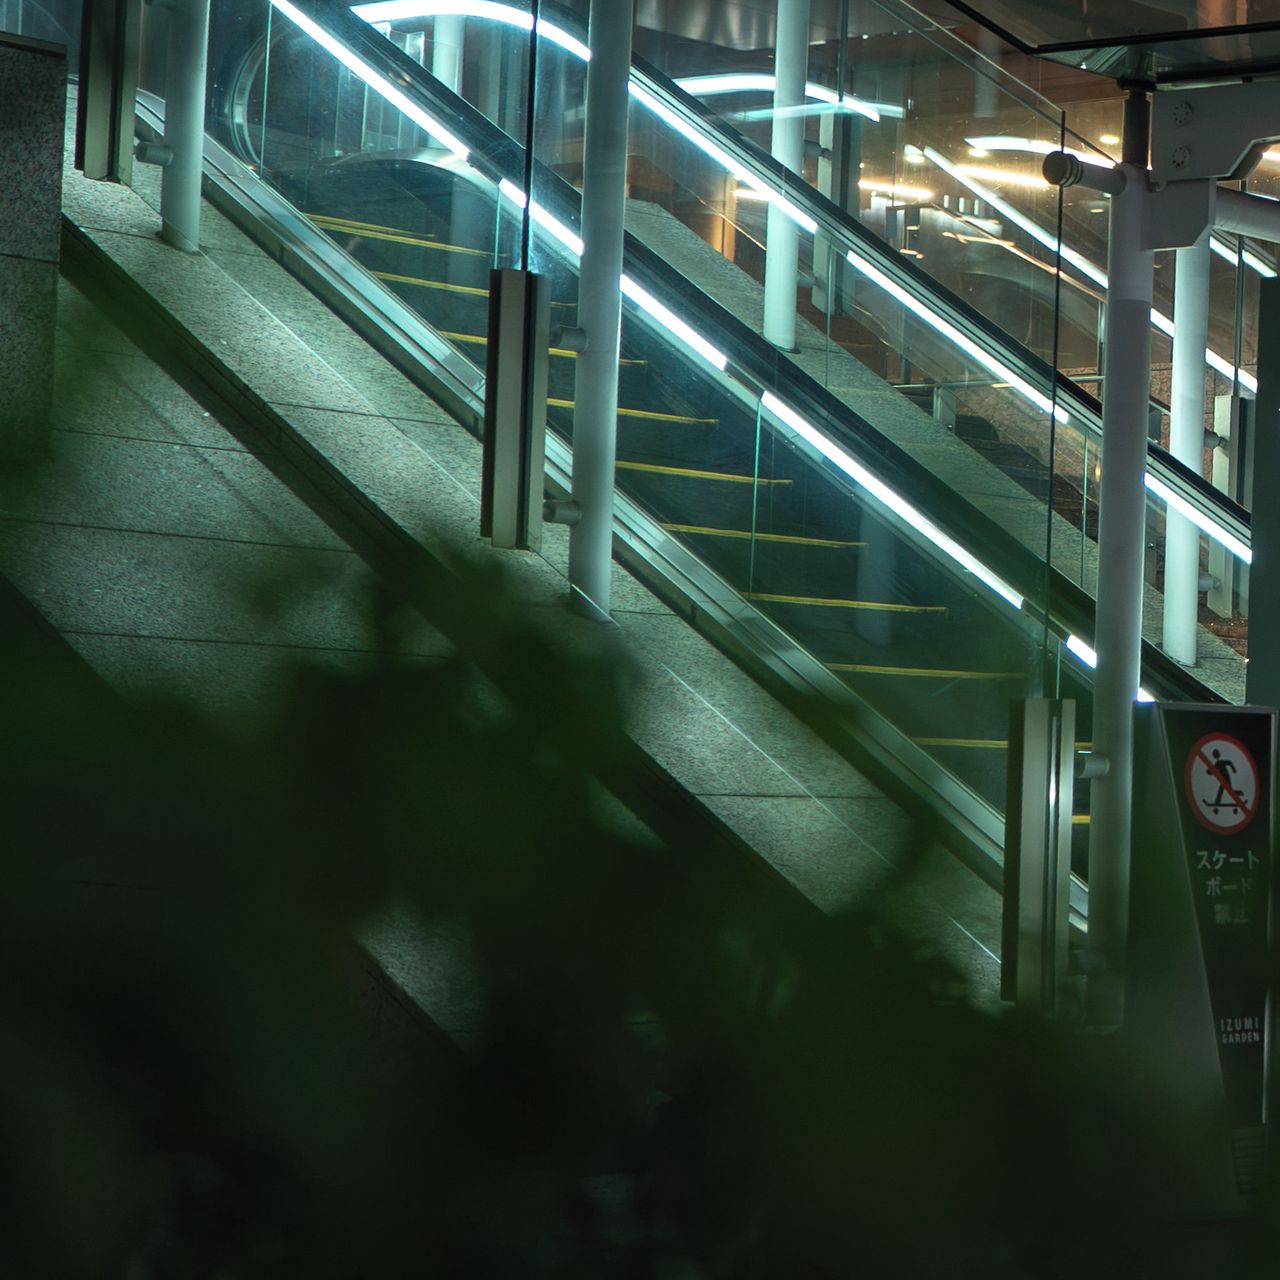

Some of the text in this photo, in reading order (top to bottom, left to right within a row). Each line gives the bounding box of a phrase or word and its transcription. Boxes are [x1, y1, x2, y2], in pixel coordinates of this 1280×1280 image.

[1195, 849, 1260, 870] スケート
[1220, 1016, 1260, 1032] IZUMI
[1221, 1031, 1260, 1045] GARDEN
